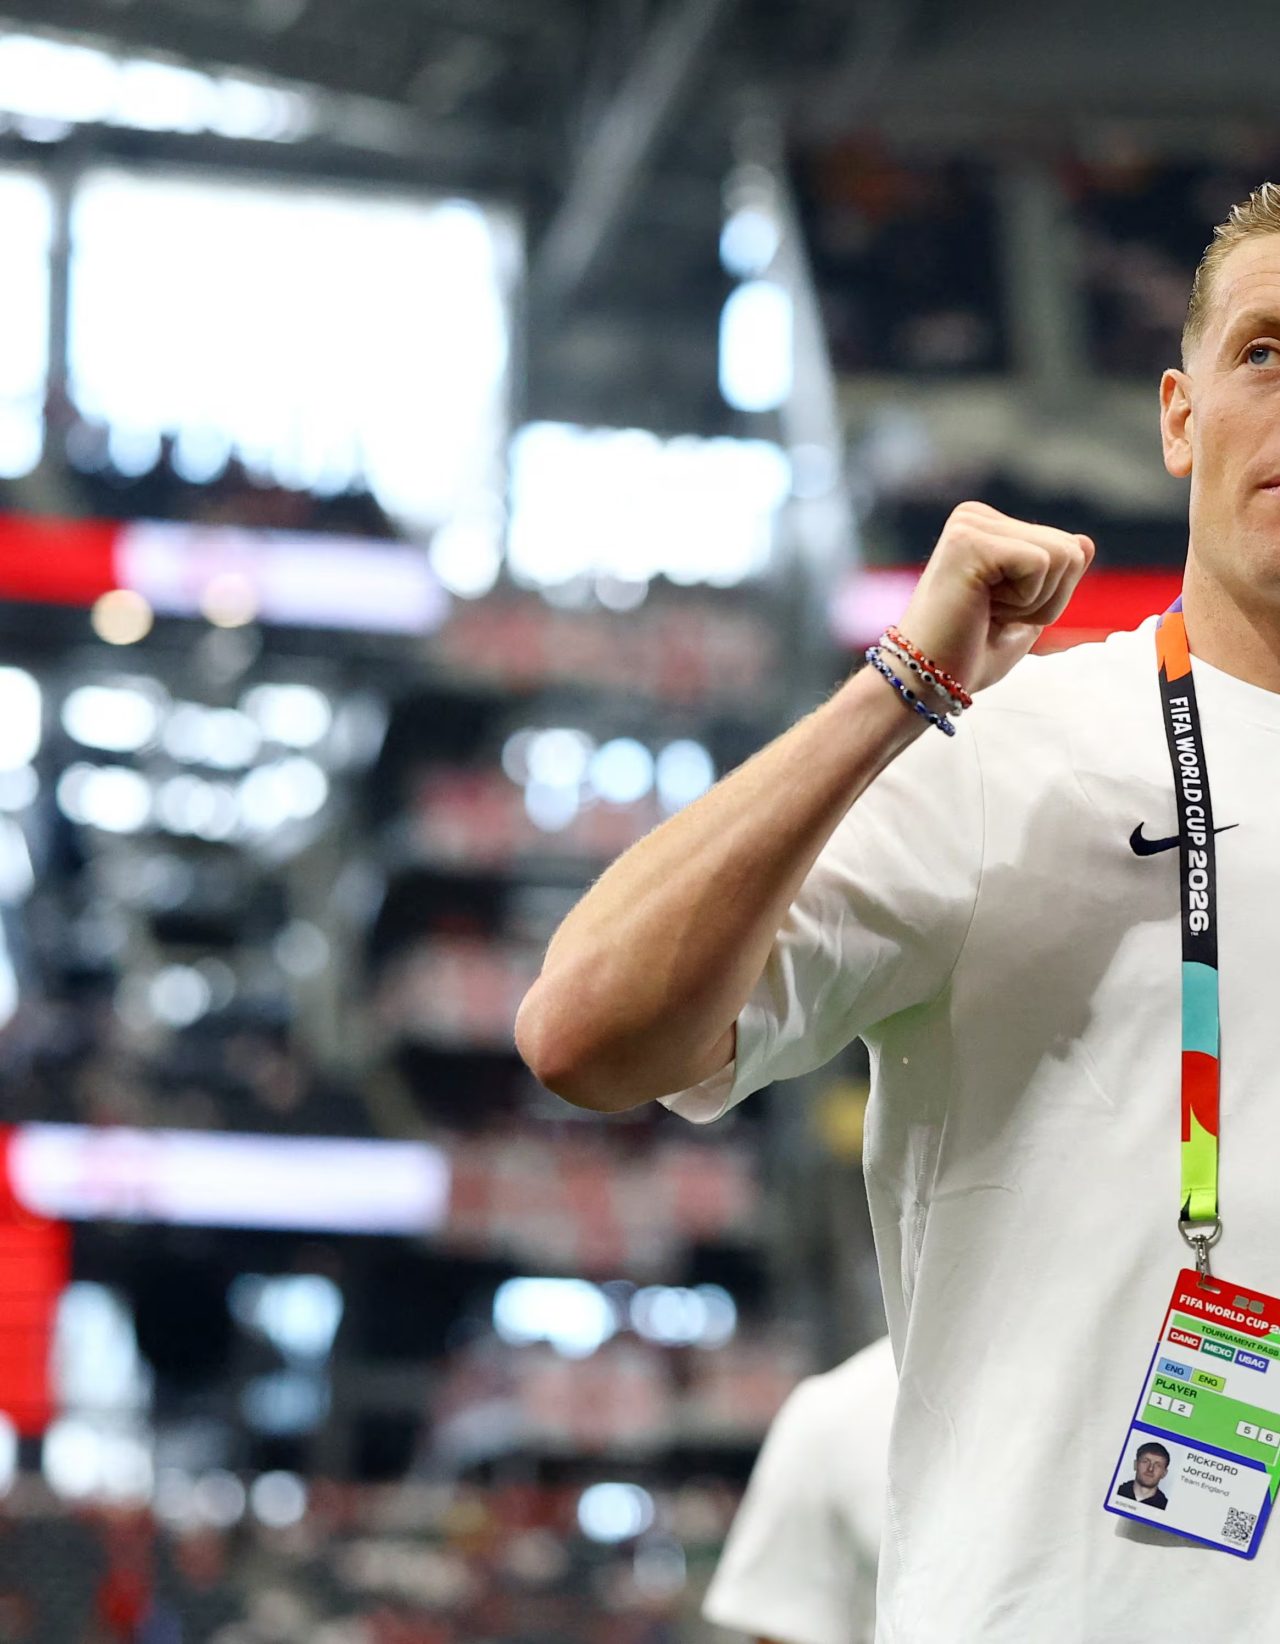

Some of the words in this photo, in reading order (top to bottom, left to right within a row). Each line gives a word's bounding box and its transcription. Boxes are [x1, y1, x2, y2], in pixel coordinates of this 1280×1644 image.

[1169, 696, 1193, 735] FIFA
[1175, 736, 1203, 802] WORLD
[1185, 804, 1207, 846] CUP
[1188, 849, 1209, 932] 2026
[1179, 1294, 1203, 1310] FIFA
[1205, 1302, 1245, 1322] WORLD
[1246, 1316, 1269, 1331] CUP
[1170, 1331, 1199, 1347] CANC
[1204, 1342, 1232, 1358] MEXC
[1238, 1355, 1266, 1369] USAC
[1201, 1325, 1256, 1349] TOURNAMENT
[1257, 1343, 1280, 1357] PASS
[1155, 1378, 1198, 1399] PLAYER
[1156, 1396, 1162, 1405] 1
[1177, 1403, 1186, 1413] 2
[1244, 1426, 1252, 1435] 5
[1265, 1433, 1273, 1442] 6
[1183, 1465, 1223, 1484] Jordan
[1186, 1452, 1239, 1476] PICKFORD
[1180, 1475, 1200, 1487] Team
[1201, 1482, 1230, 1497] England
